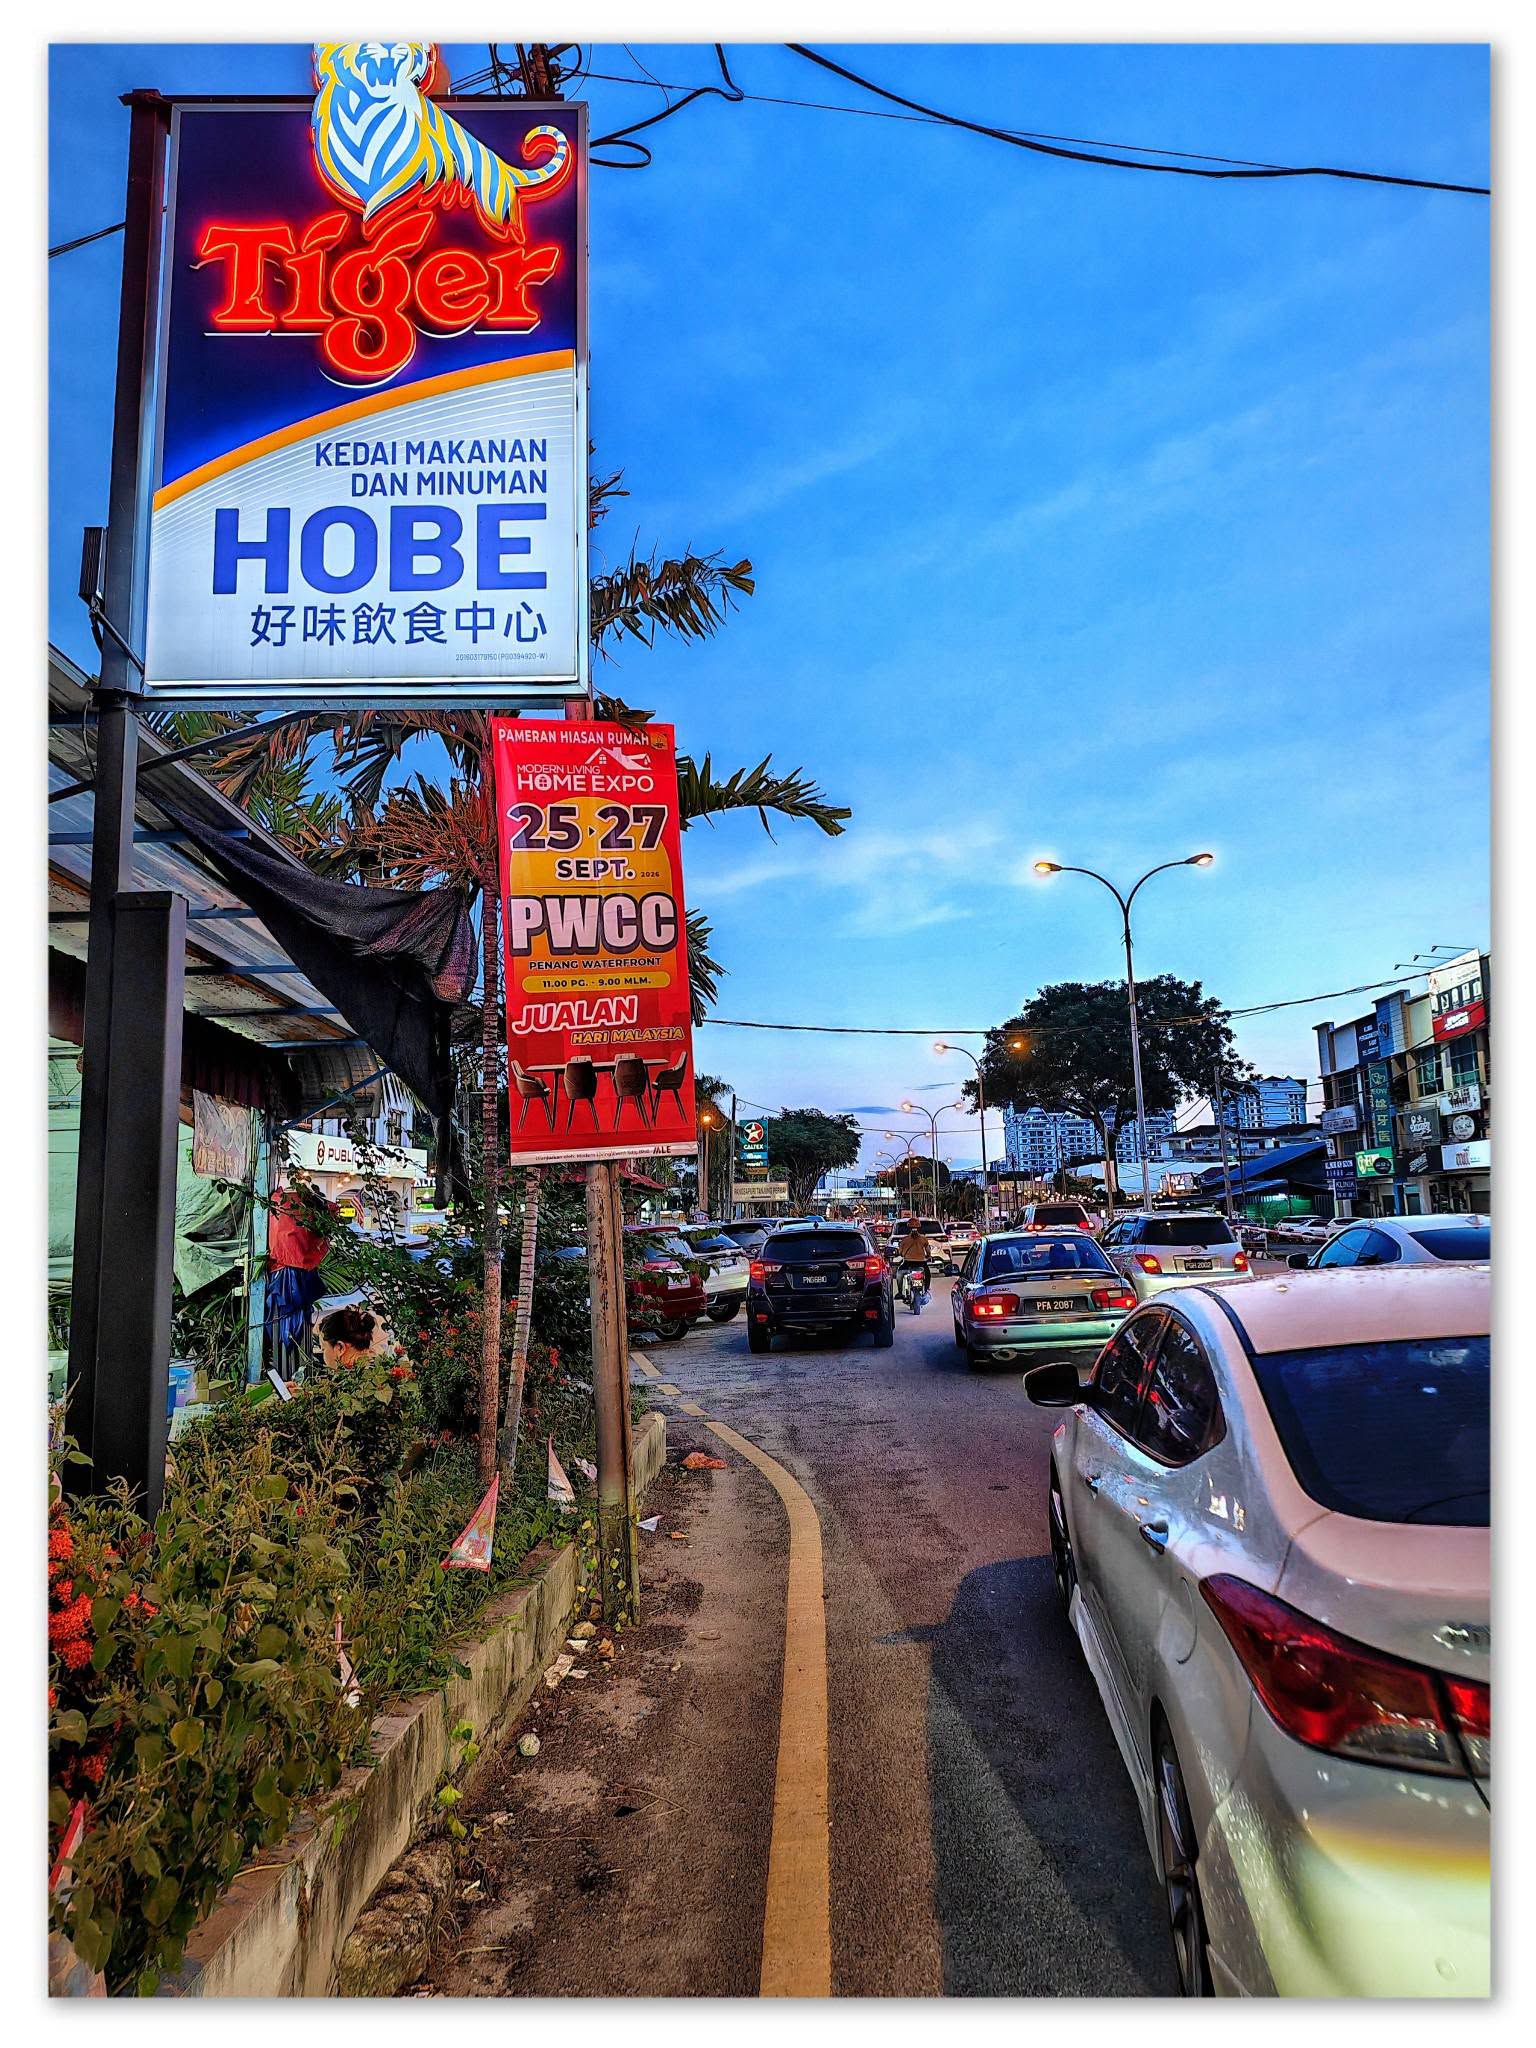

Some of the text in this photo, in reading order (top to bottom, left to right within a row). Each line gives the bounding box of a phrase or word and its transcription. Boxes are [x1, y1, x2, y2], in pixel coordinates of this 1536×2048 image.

[200, 210, 560, 378] Tiger
[315, 438, 547, 466] KEDAI MAKANAN
[351, 469, 547, 497] DAN MINUMAN
[212, 502, 547, 594] HOBE
[250, 600, 547, 647] 好味飲食中心
[498, 728, 557, 743] PAMERAN
[560, 730, 604, 745] HIASAN
[607, 731, 650, 746] RUMAH
[516, 764, 601, 775] MODERN LIVING
[517, 774, 655, 792] HOME EXPO
[507, 803, 669, 852] 25 27
[555, 857, 637, 881] SEPT.
[507, 892, 678, 956] PWCC
[528, 956, 662, 970] PENANG WATERFRONT
[542, 979, 568, 988] 11.00
[570, 979, 589, 988] PG.
[598, 977, 621, 986] 9.00
[623, 976, 652, 986] MLM.
[511, 994, 638, 1035] JUALAN
[570, 1026, 686, 1046] HARI MALAYSIA
[1036, 1300, 1074, 1311] PFA 2087
